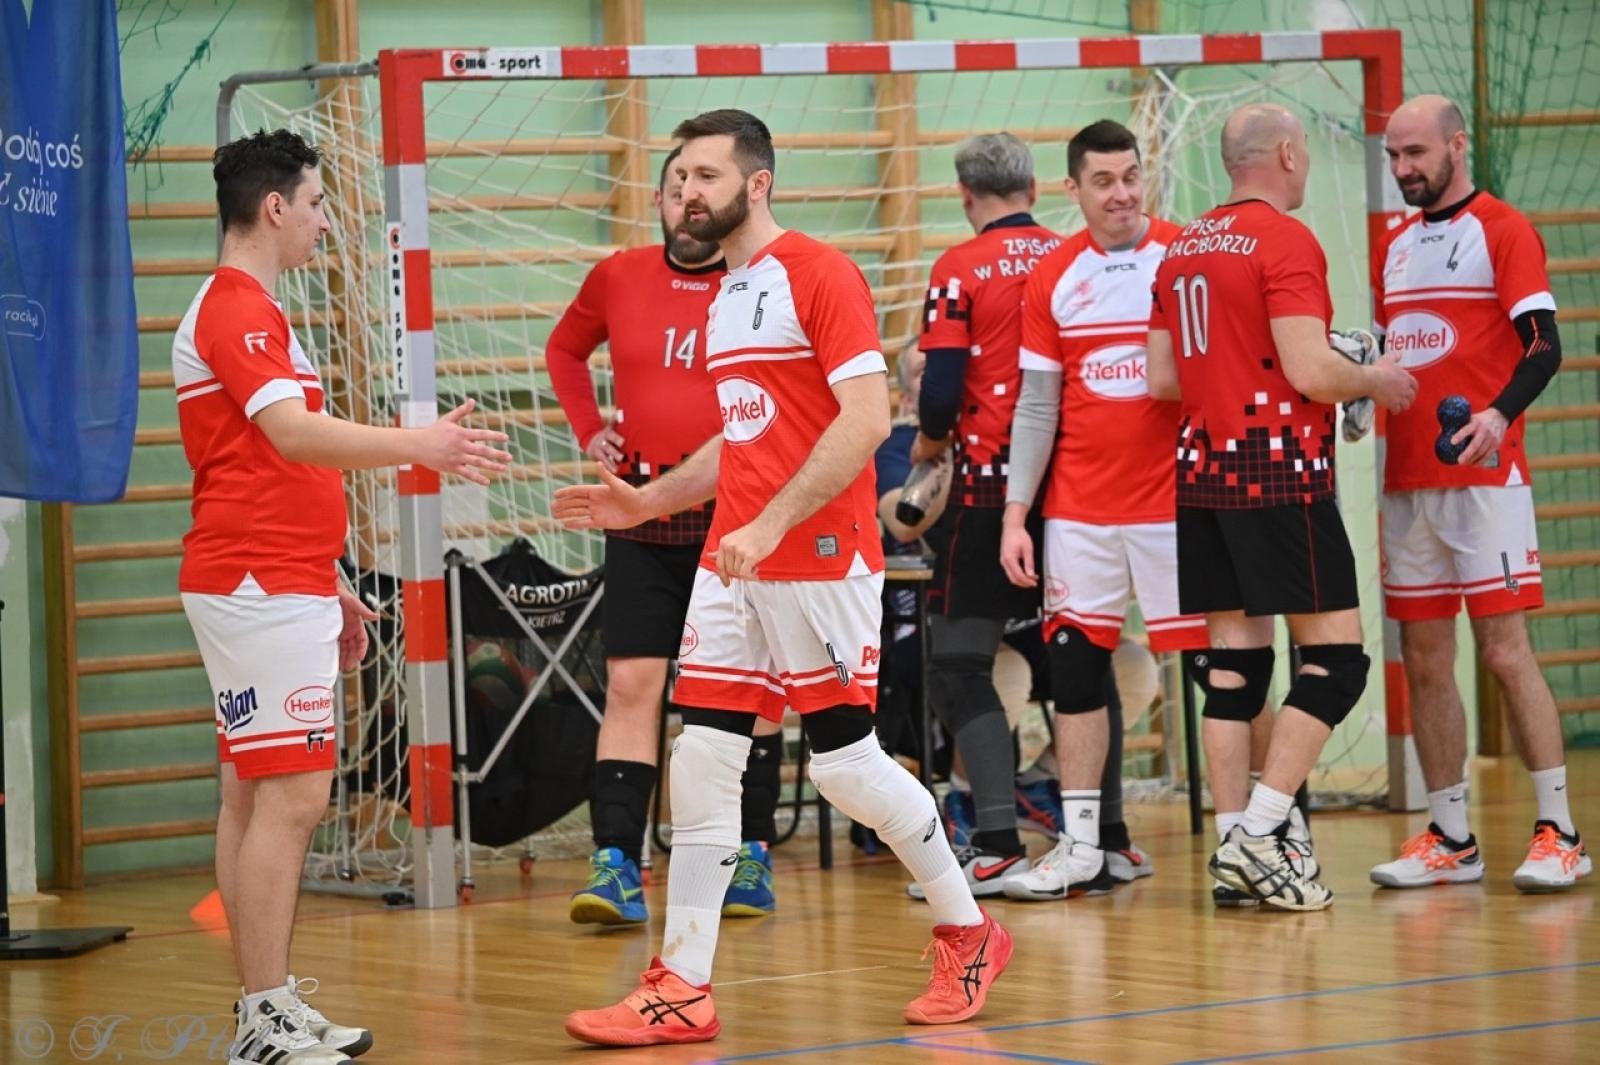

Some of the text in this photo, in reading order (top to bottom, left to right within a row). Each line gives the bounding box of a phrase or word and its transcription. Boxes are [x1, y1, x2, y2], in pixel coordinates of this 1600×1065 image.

[499, 54, 541, 73] sport
[45, 133, 84, 170] coś
[1172, 273, 1209, 358] 10
[664, 326, 698, 369] 14
[1387, 327, 1446, 351] Henkel
[1086, 359, 1145, 380] Henk
[720, 393, 767, 424] enkel
[217, 686, 259, 731] Silan
